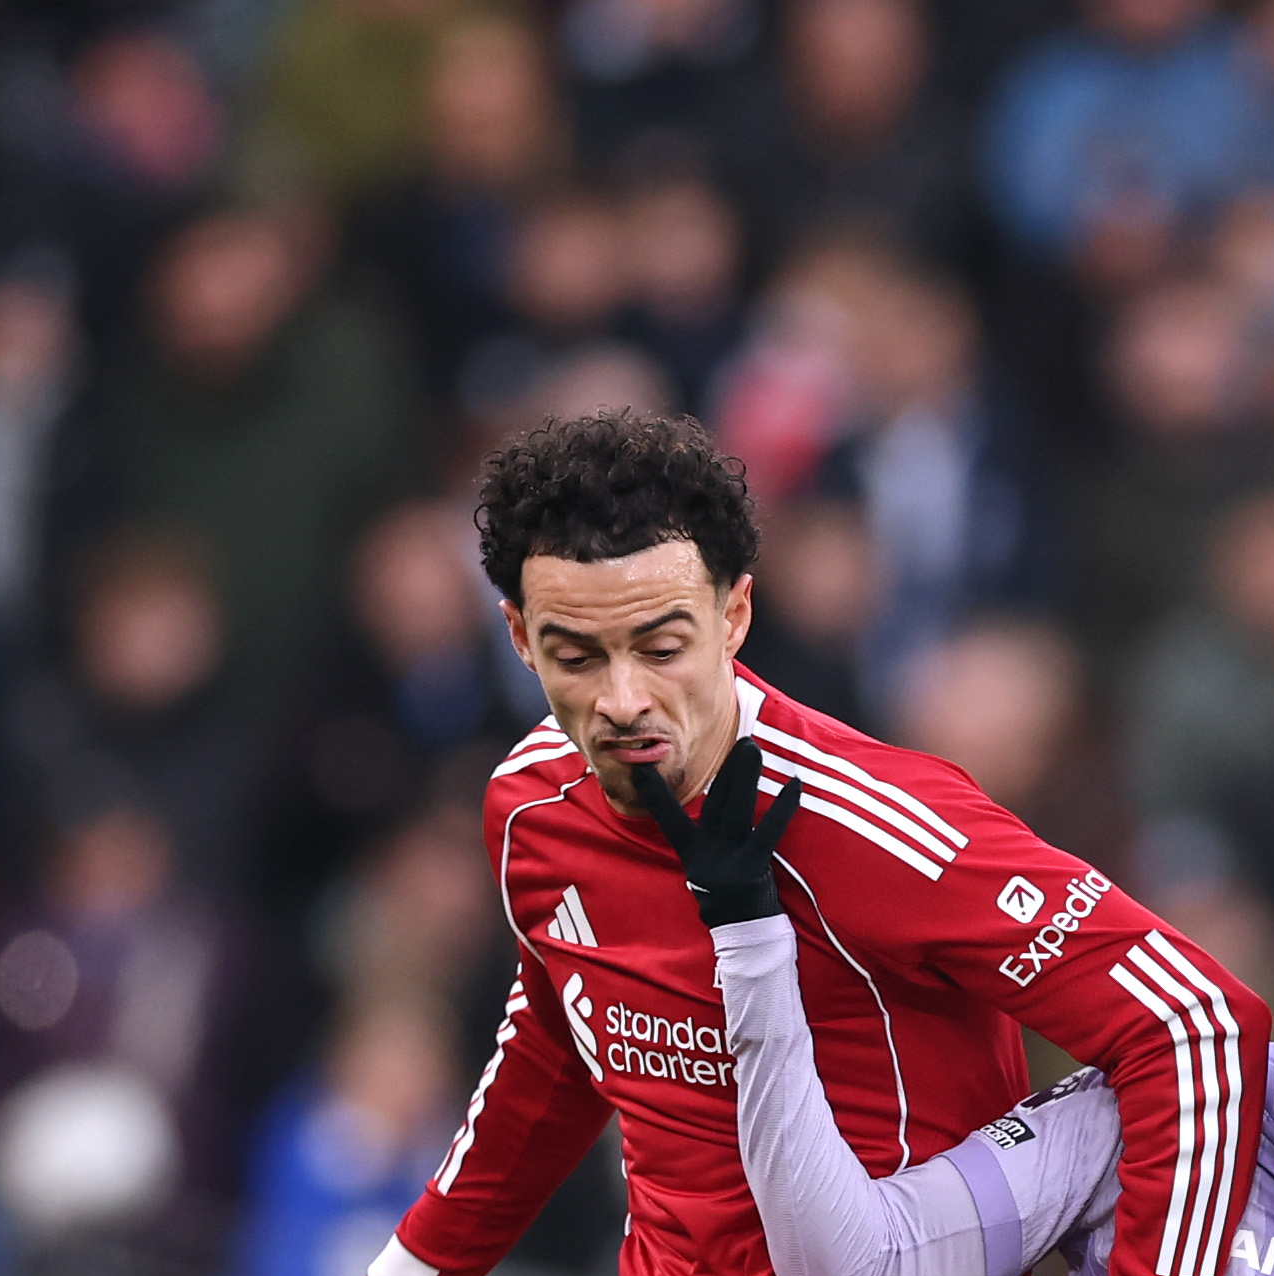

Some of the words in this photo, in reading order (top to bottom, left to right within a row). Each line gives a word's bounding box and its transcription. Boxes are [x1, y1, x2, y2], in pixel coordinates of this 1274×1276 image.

[998, 869, 1112, 987] Expedia
[606, 1001, 733, 1054] standar
[607, 1039, 739, 1087] charter
